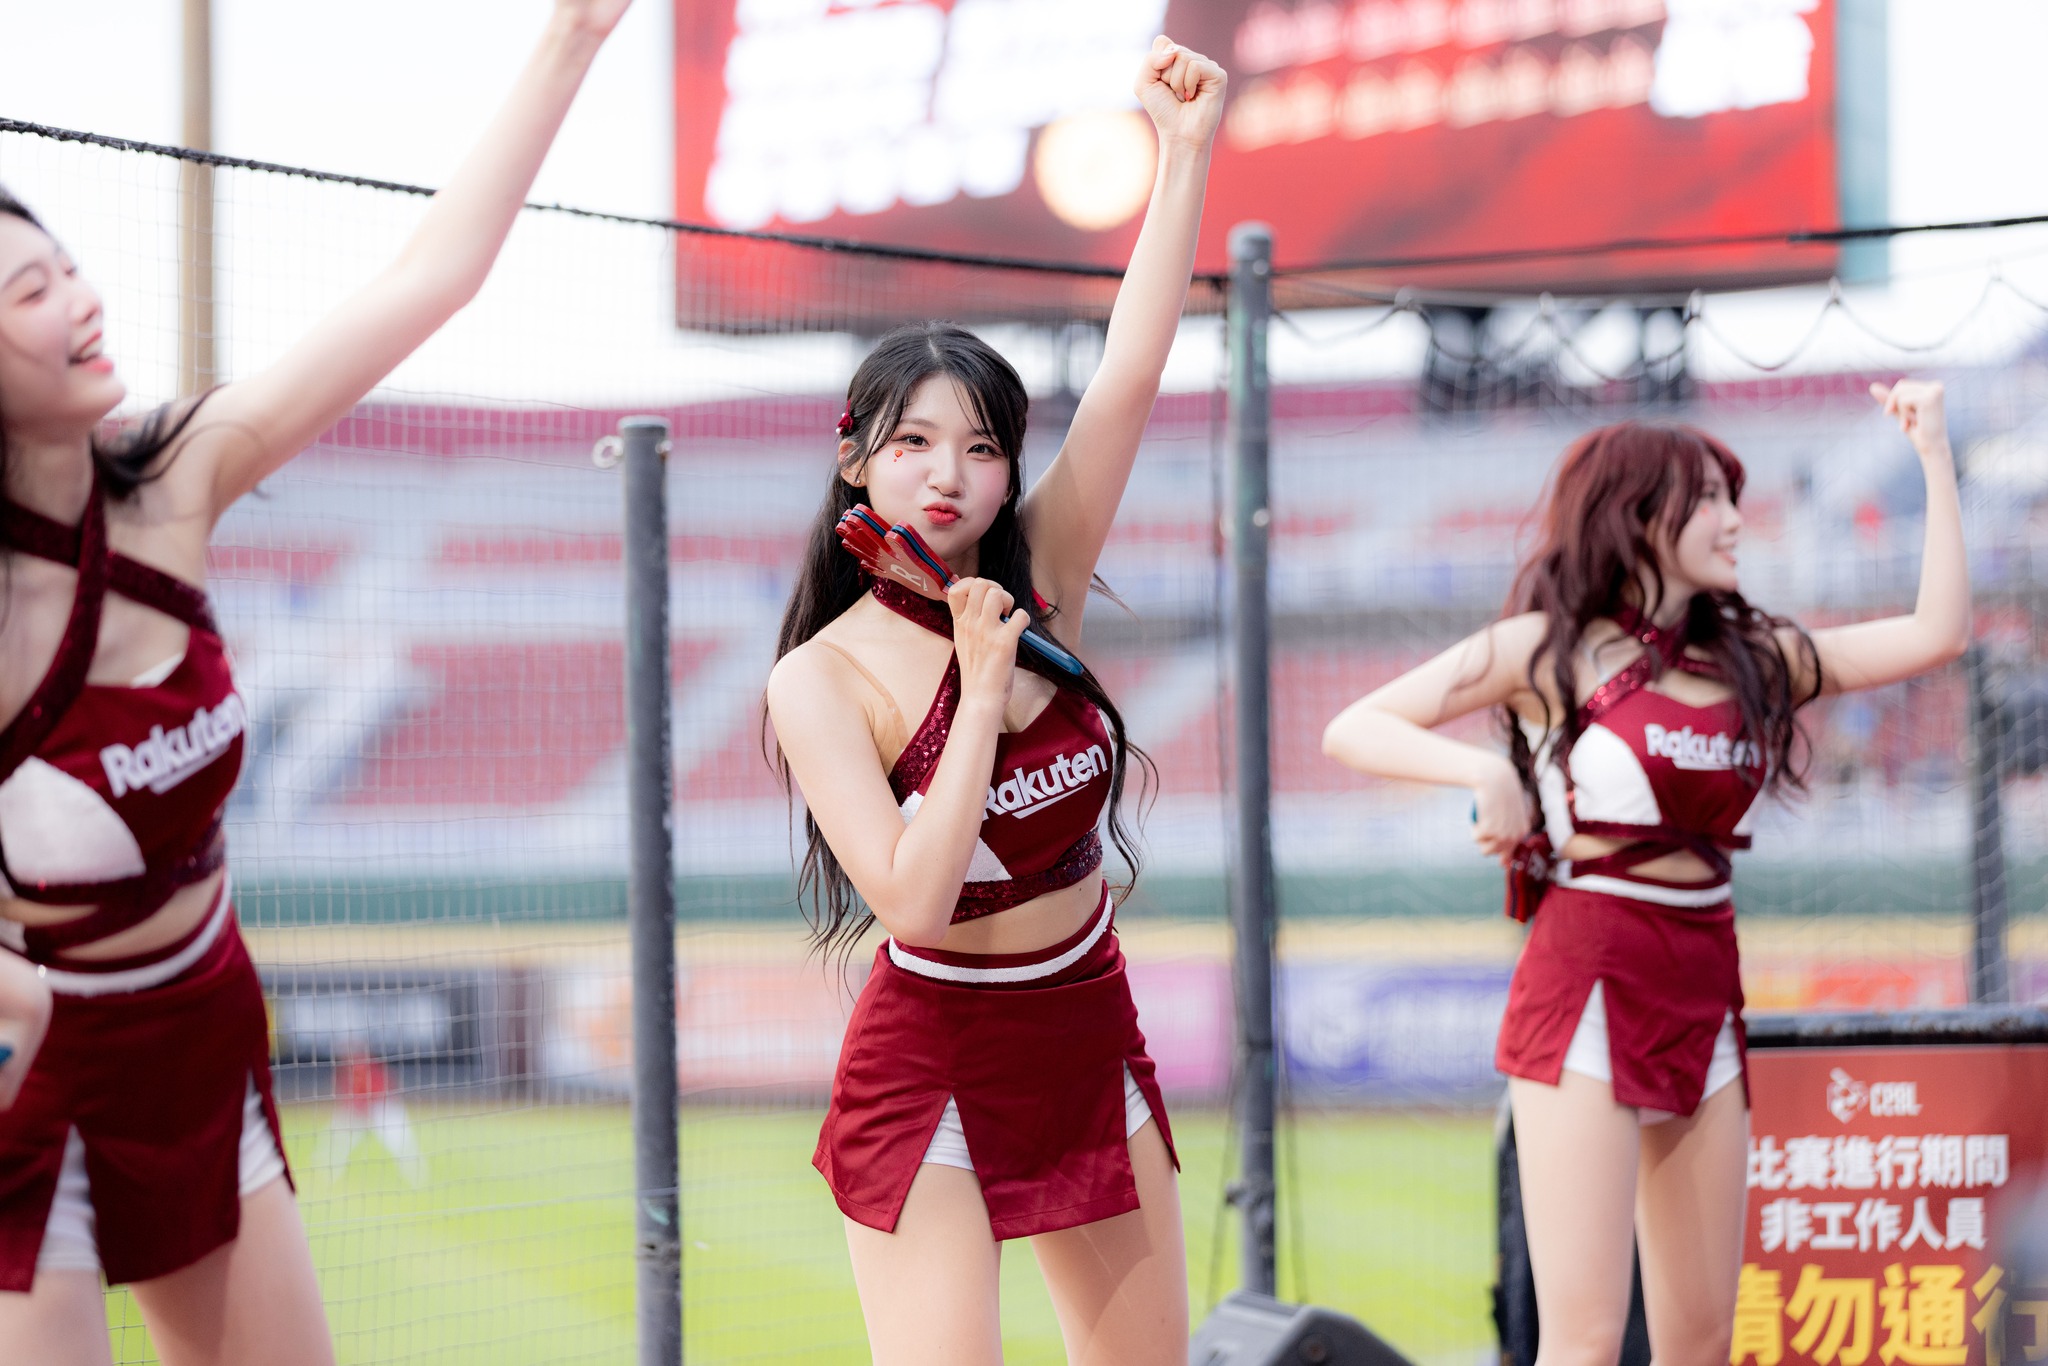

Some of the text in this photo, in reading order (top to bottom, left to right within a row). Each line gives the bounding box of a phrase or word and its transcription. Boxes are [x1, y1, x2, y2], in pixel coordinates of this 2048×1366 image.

[1747, 1134, 2009, 1189] 比賽進行期間
[1759, 1197, 1987, 1252] 非工作人員
